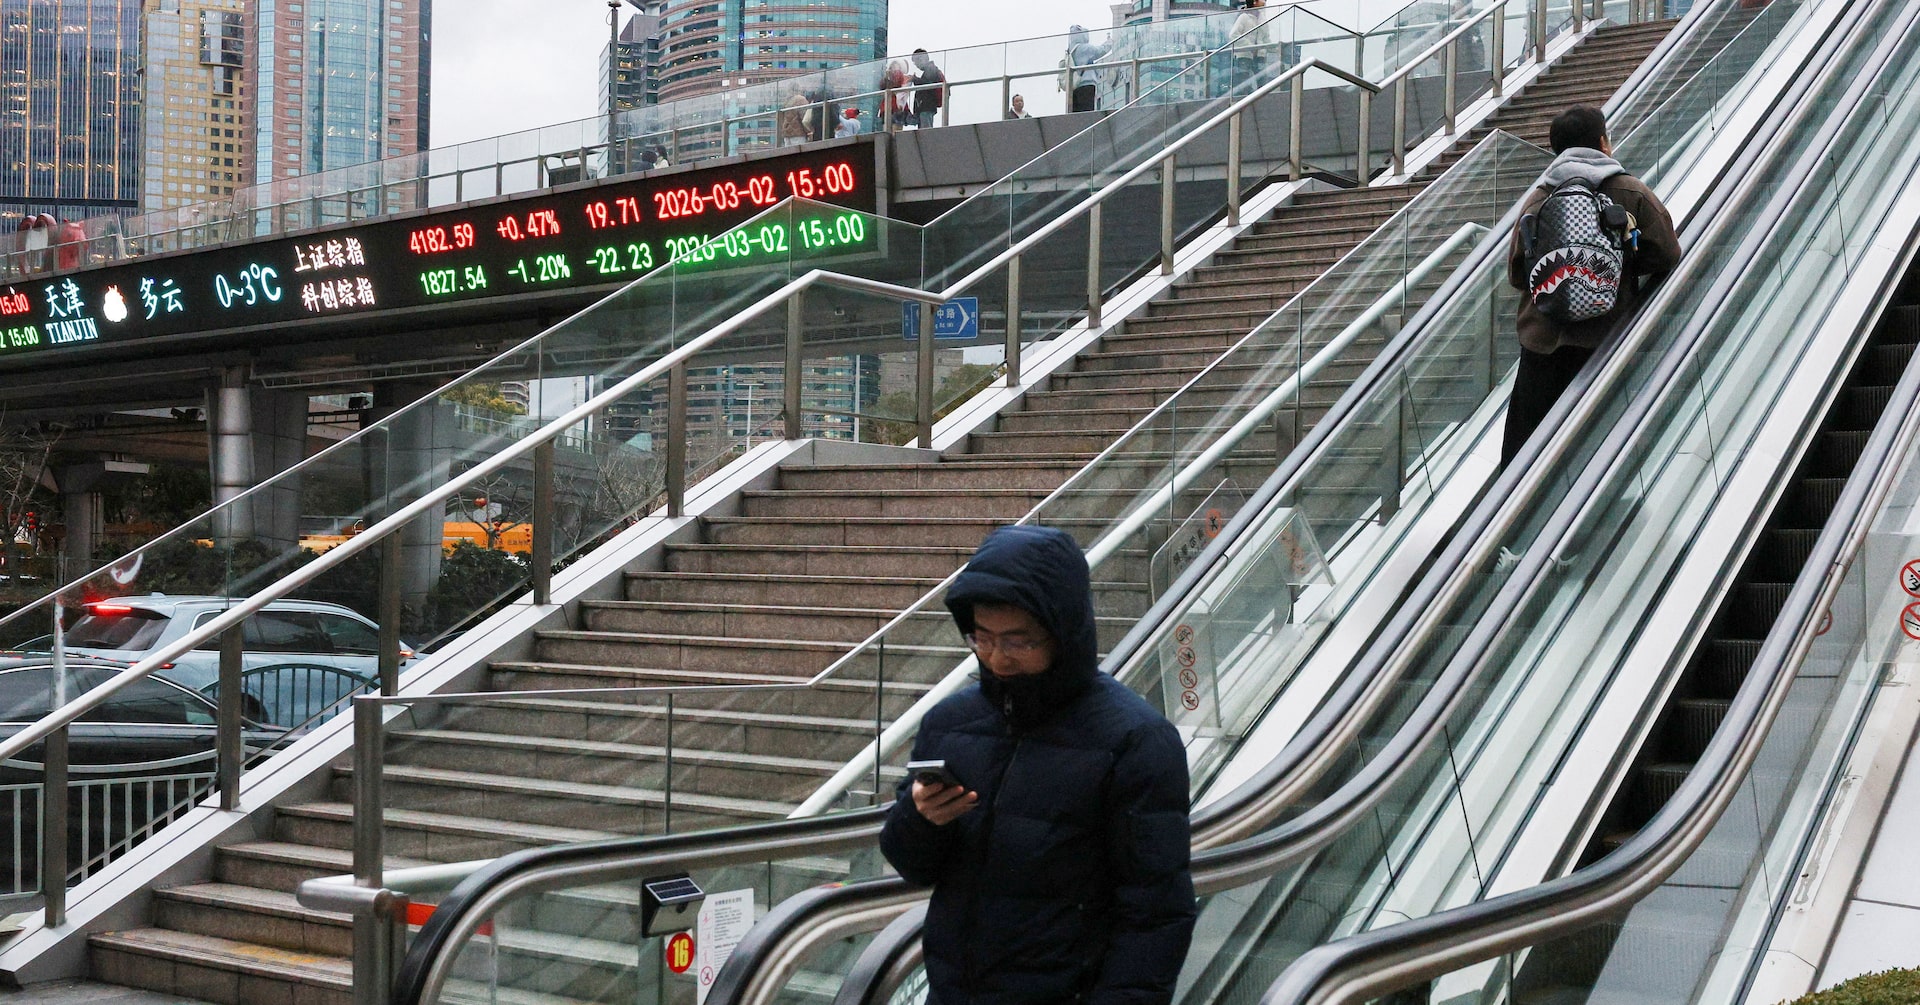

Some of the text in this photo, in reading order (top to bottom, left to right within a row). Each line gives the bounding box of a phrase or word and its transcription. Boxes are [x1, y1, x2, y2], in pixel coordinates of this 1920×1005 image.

[295, 163, 854, 273] 上证综指 4182.59 +0.47% 19.71 2026-03-02 15:00
[302, 213, 864, 313] 科创综指 1827.54 -1.20% -22.23 2026-03-02 15:00
[0, 293, 29, 314] 15:00
[45, 278, 84, 318] 天津
[140, 277, 183, 320] 多云
[8, 326, 39, 347] 15:00
[45, 317, 98, 344] TIANJIN
[673, 938, 689, 968] 16
